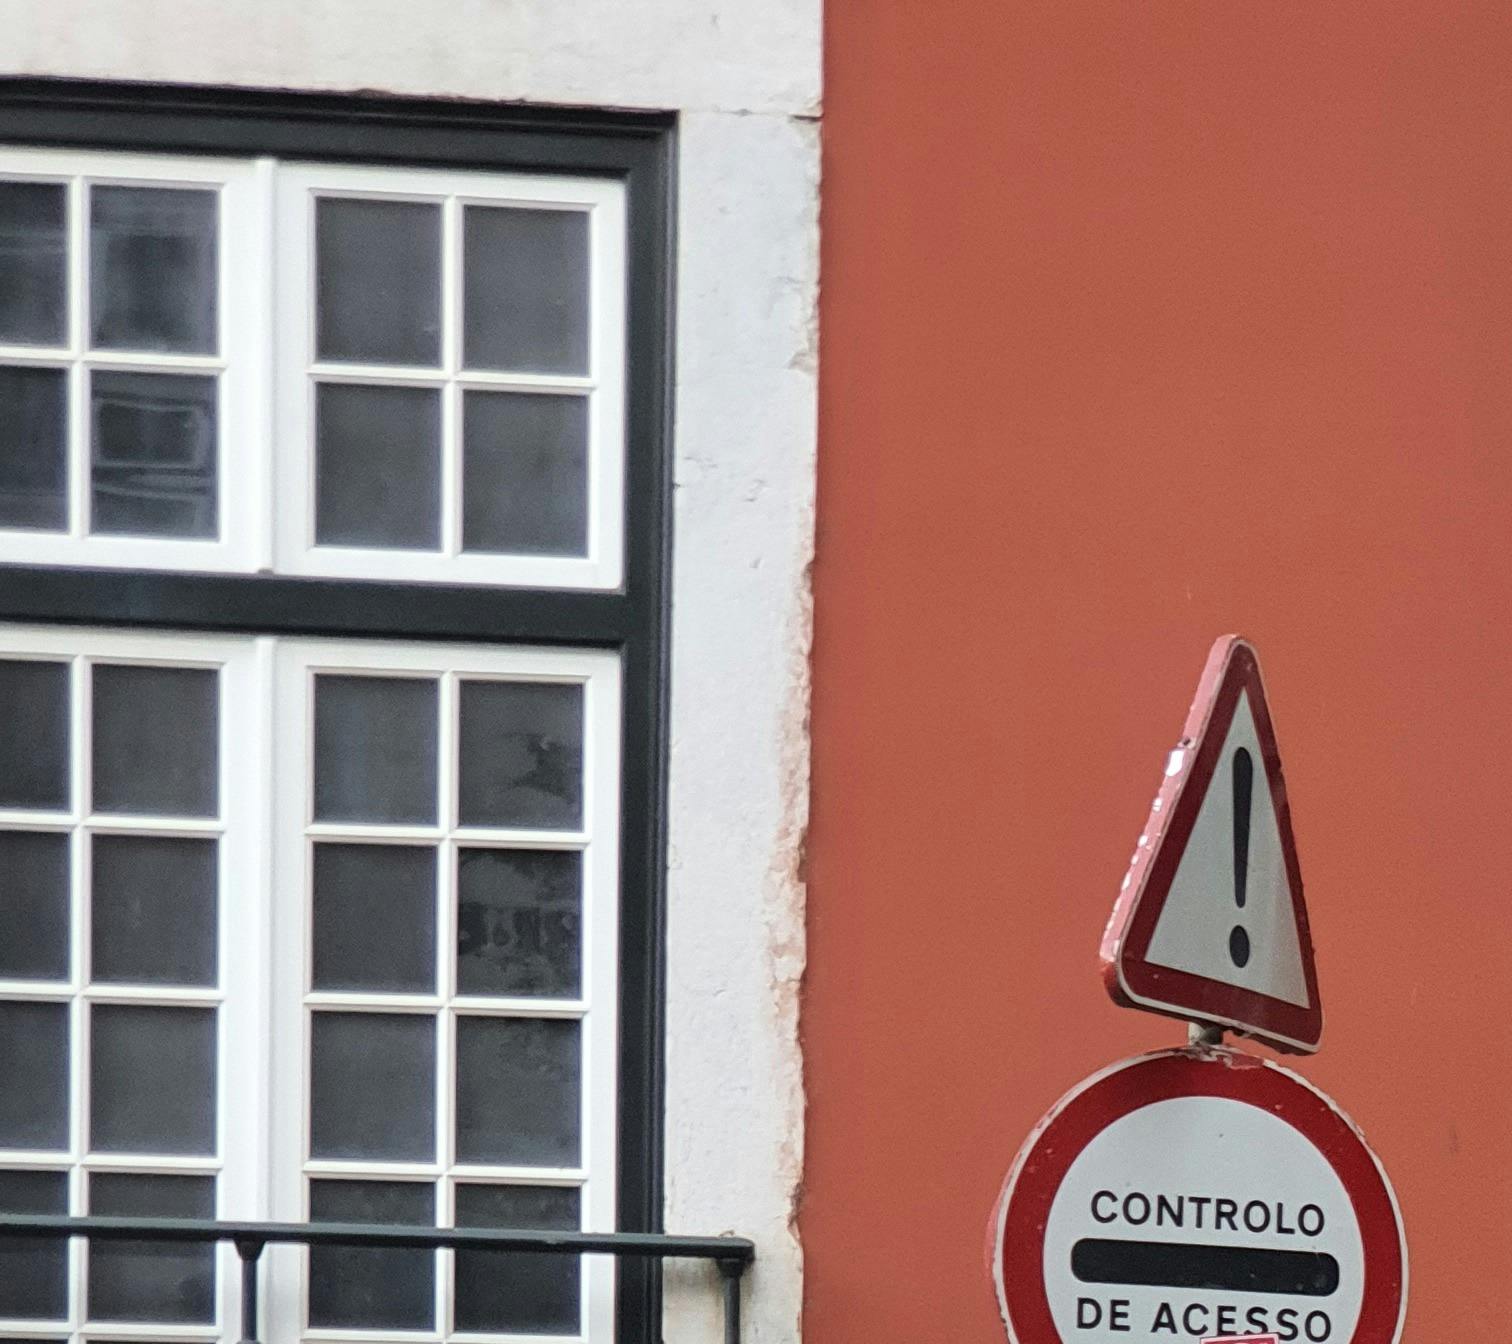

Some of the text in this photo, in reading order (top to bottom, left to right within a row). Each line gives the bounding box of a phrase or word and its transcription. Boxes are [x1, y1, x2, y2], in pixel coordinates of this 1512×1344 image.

[1090, 1190, 1325, 1237] CONTROLO
[1076, 1297, 1332, 1343] DE ACESSO
